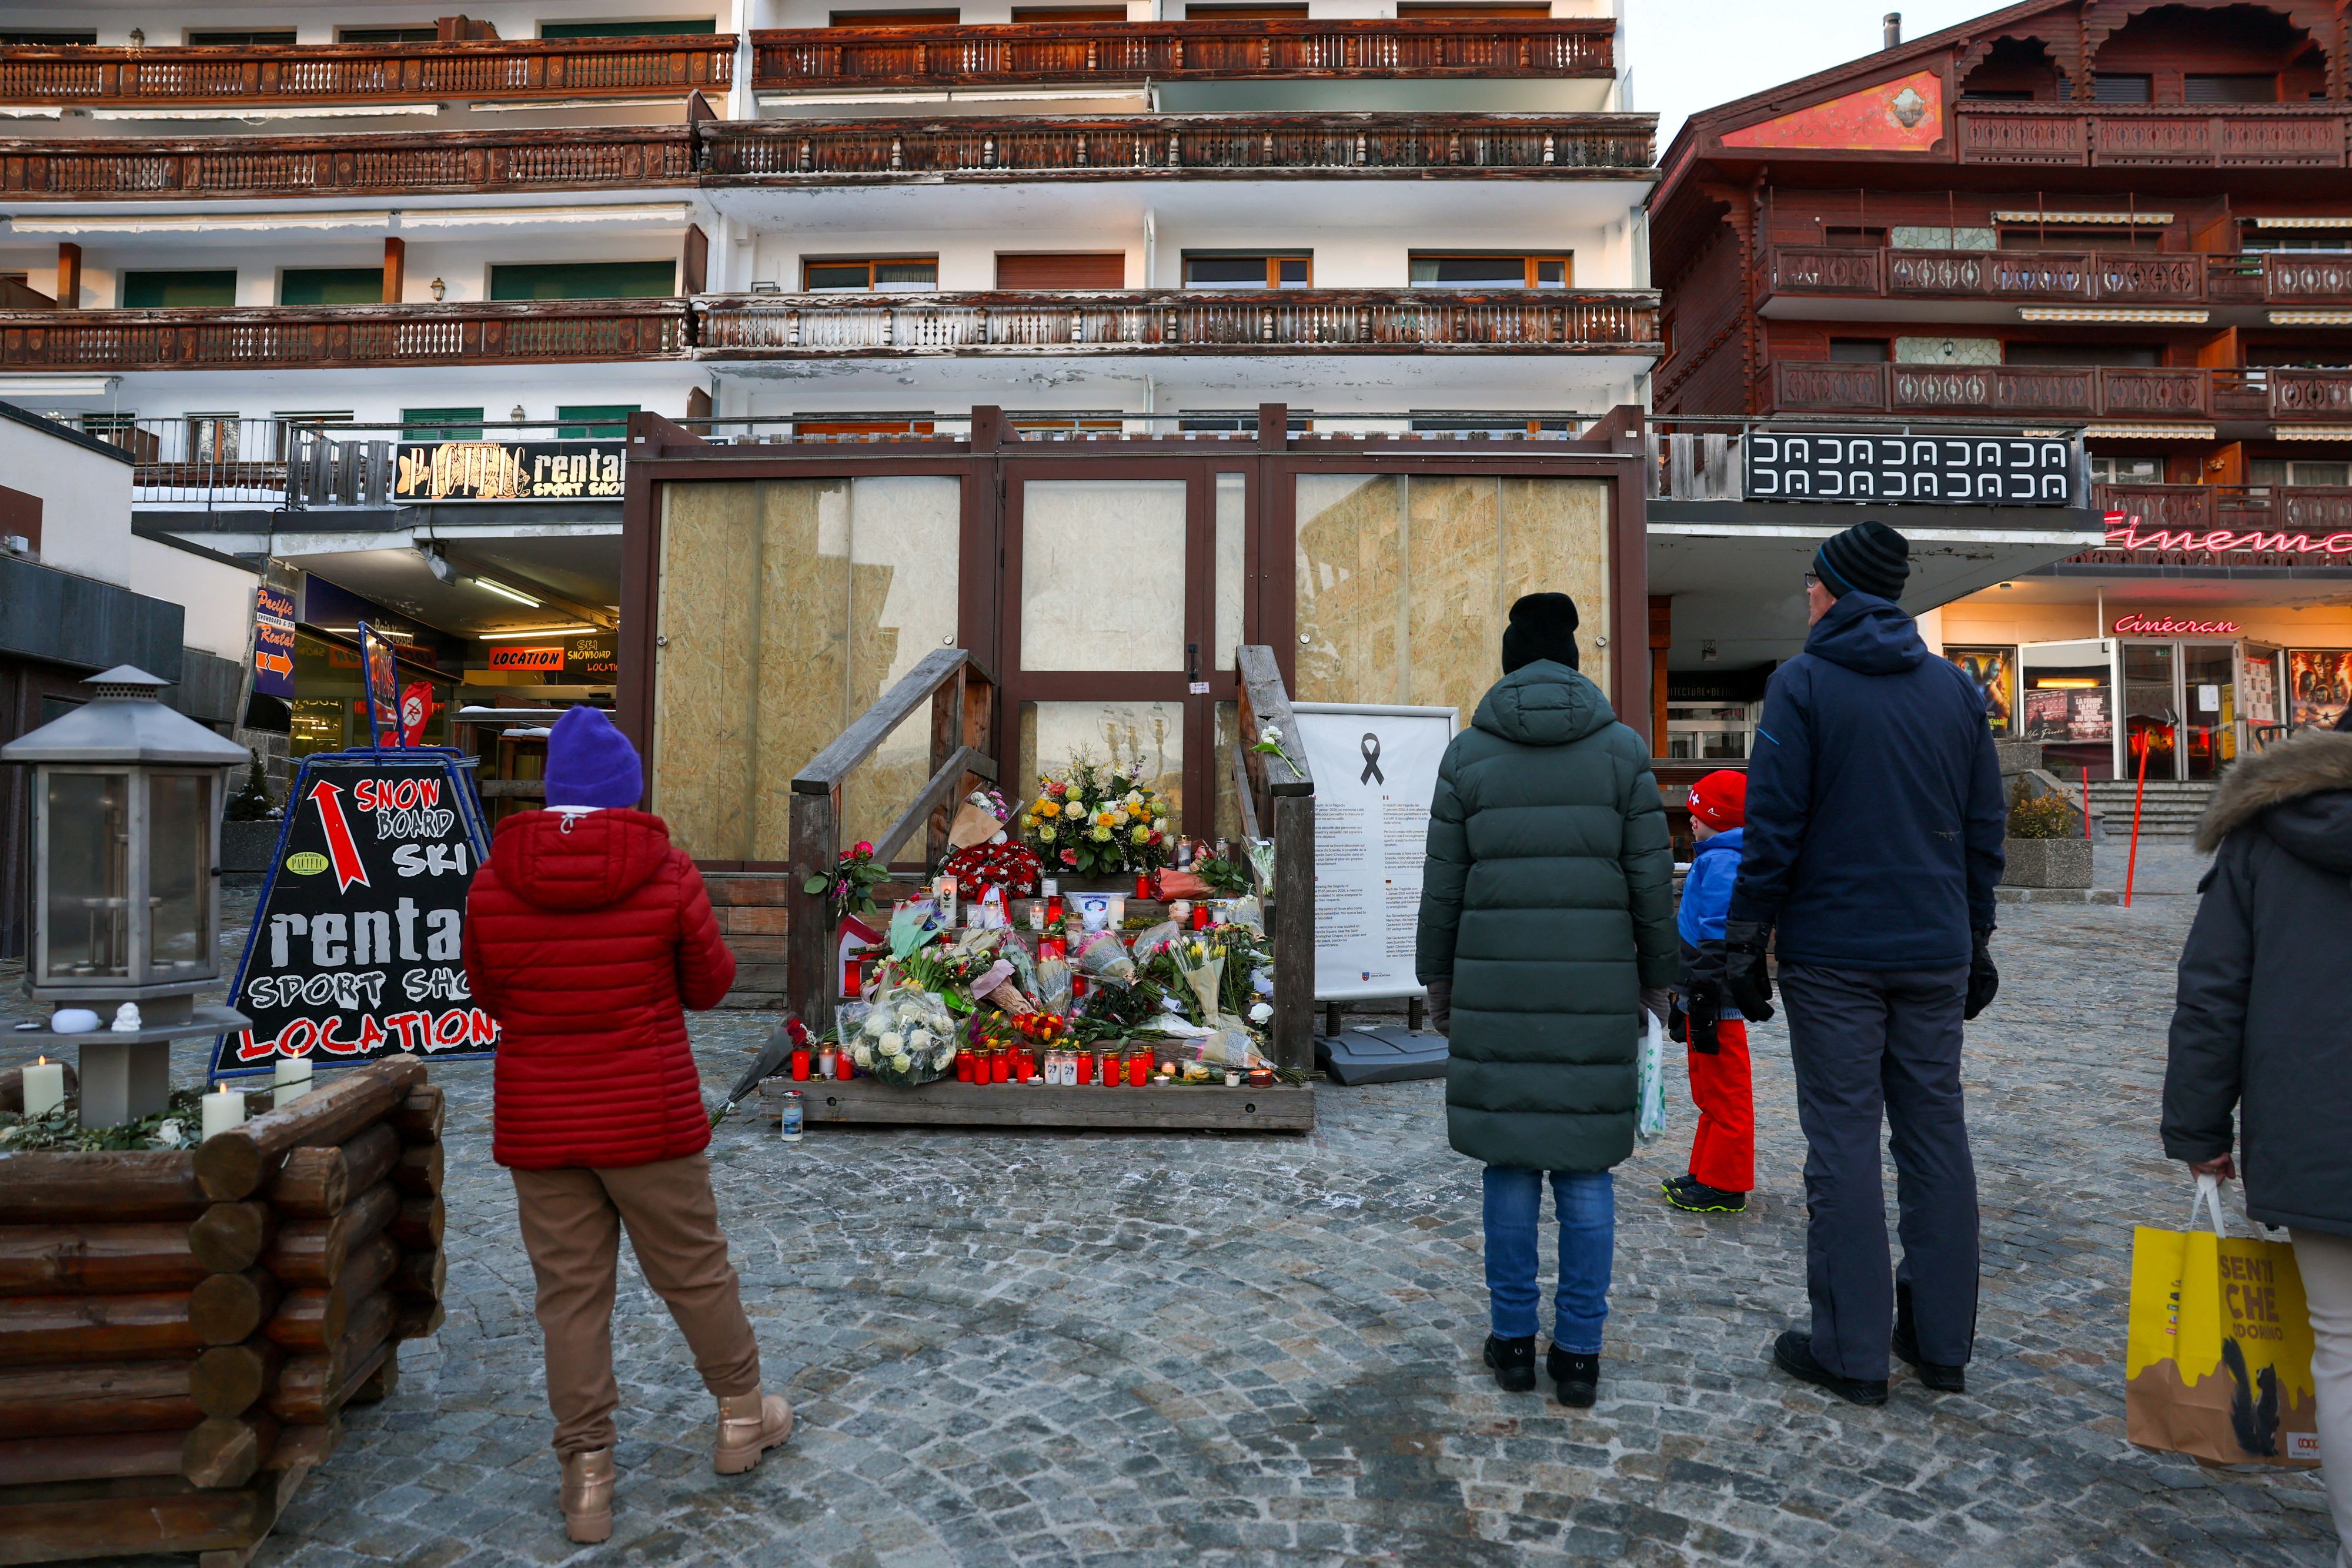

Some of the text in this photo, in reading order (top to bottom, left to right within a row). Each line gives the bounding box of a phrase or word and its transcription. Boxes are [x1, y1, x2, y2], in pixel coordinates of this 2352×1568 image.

[408, 446, 626, 497] PACIFIC rental
[532, 482, 583, 497] SPORT
[258, 590, 293, 617] Pacific
[258, 614, 282, 626] SNOWBOARD
[2113, 613, 2241, 633] Cinécran
[260, 624, 295, 648] Rental
[577, 640, 597, 650] SKI
[493, 651, 560, 666] LOCATION
[567, 650, 611, 660] SNOWBOARD
[354, 778, 440, 811] SNOW
[377, 809, 455, 840] BOARD
[292, 858, 323, 868] PACIFIC
[392, 842, 467, 878] SKI
[269, 897, 467, 967] renta
[248, 971, 386, 1010] SPORT
[2220, 1254, 2274, 1283] SENTI
[2226, 1284, 2279, 1322] CHE
